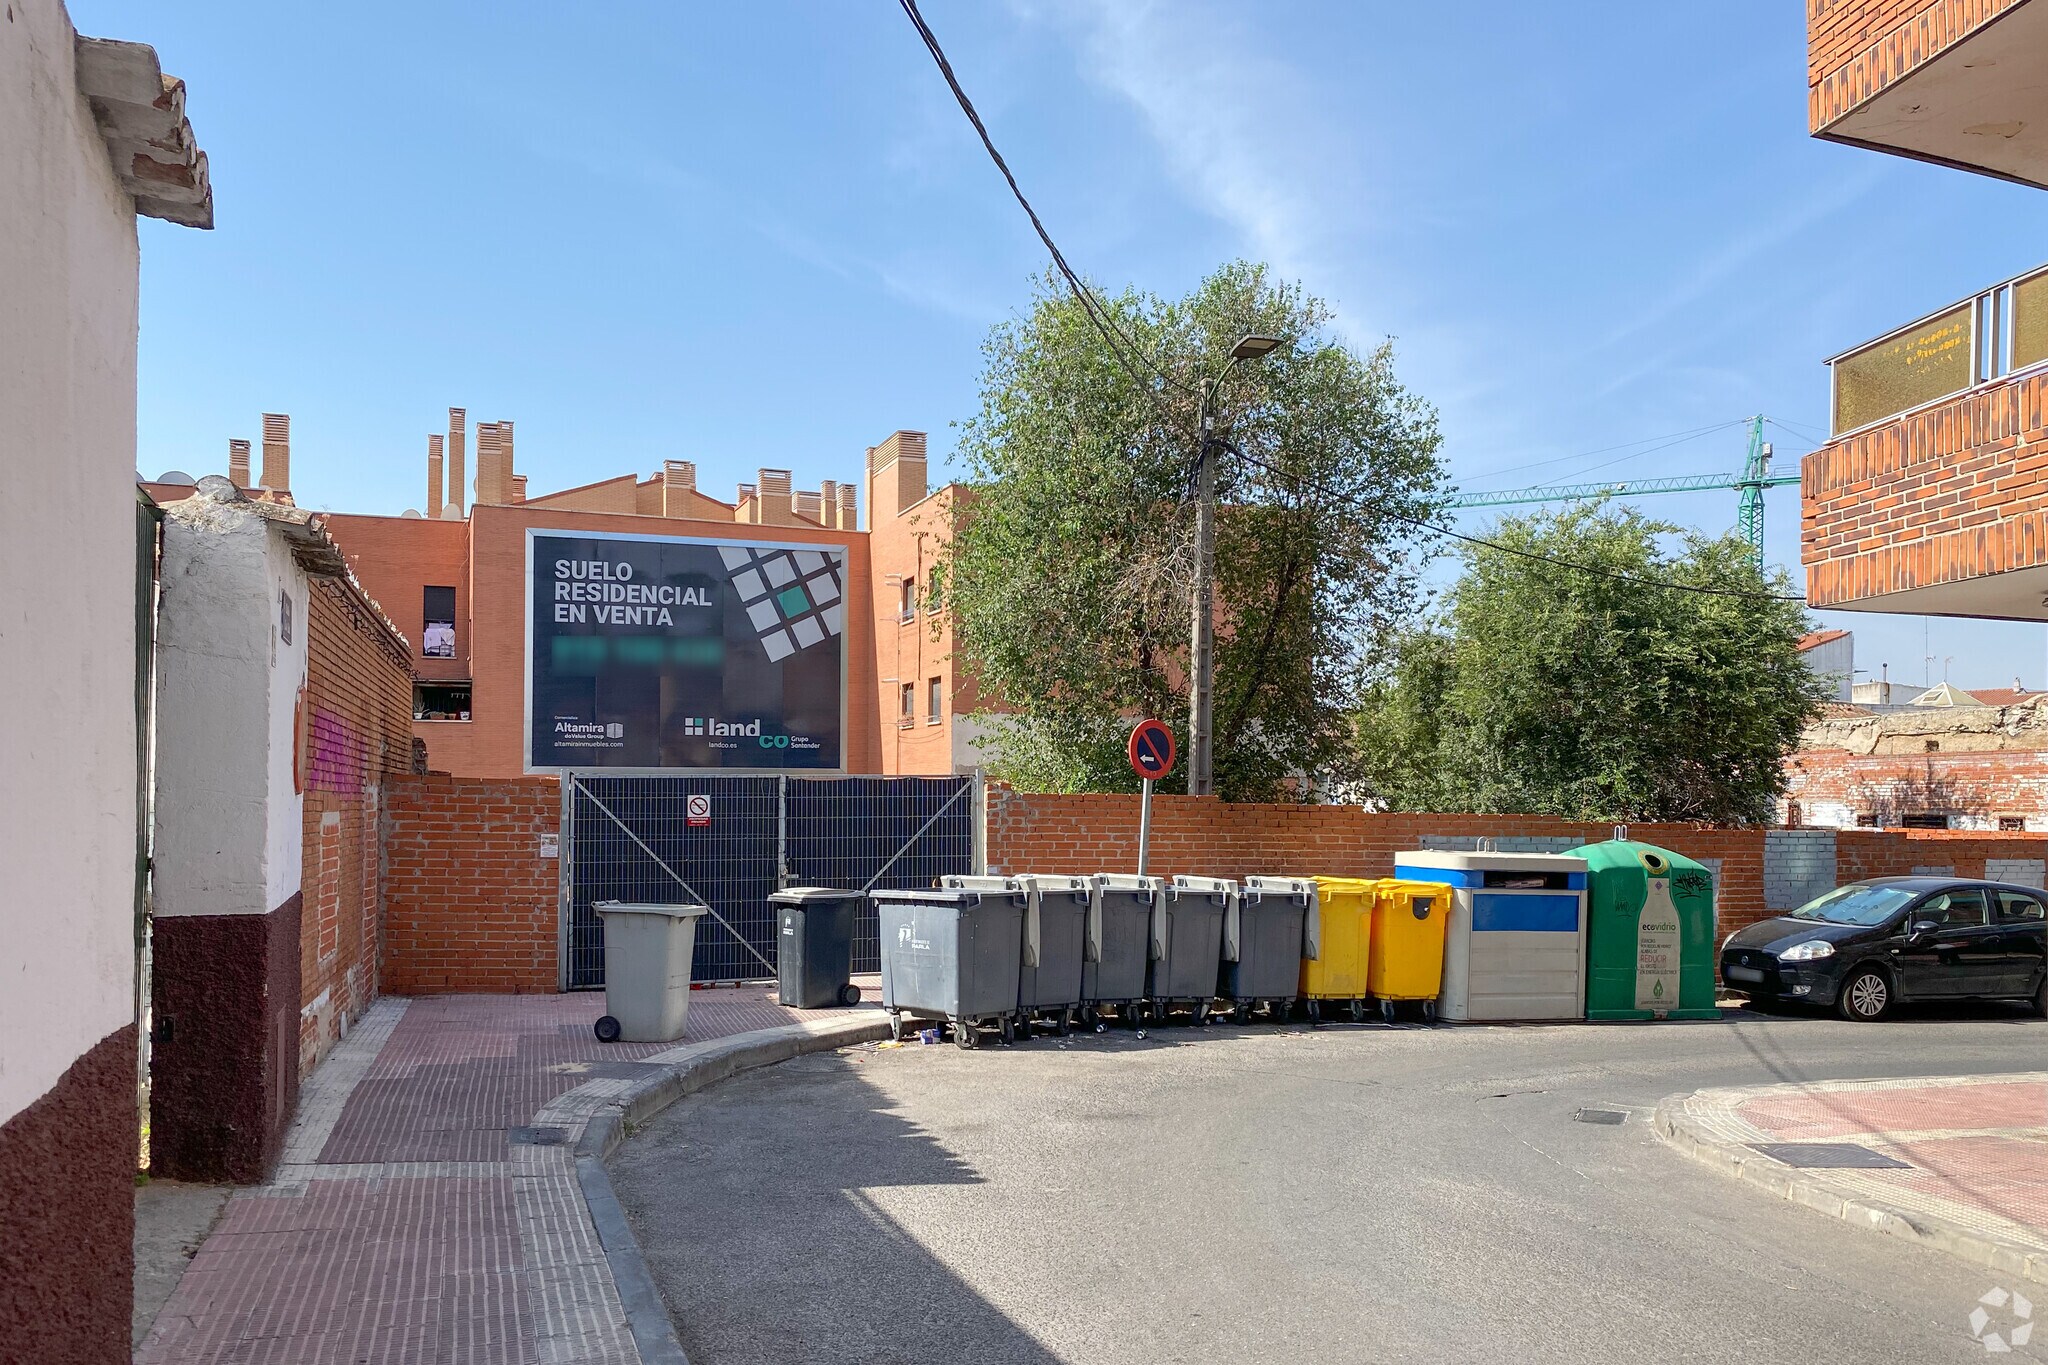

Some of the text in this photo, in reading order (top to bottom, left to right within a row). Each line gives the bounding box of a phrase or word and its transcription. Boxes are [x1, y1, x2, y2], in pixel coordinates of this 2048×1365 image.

[555, 559, 633, 582] SUELO
[555, 582, 712, 607] RESIDENCIAL
[555, 604, 674, 626] EN VENTA
[554, 722, 605, 733] Altamira
[791, 735, 809, 743] Grupo
[708, 741, 738, 749] landco.es
[1642, 922, 1676, 930] ecovidrio
[1640, 955, 1666, 963] REDUCIR
